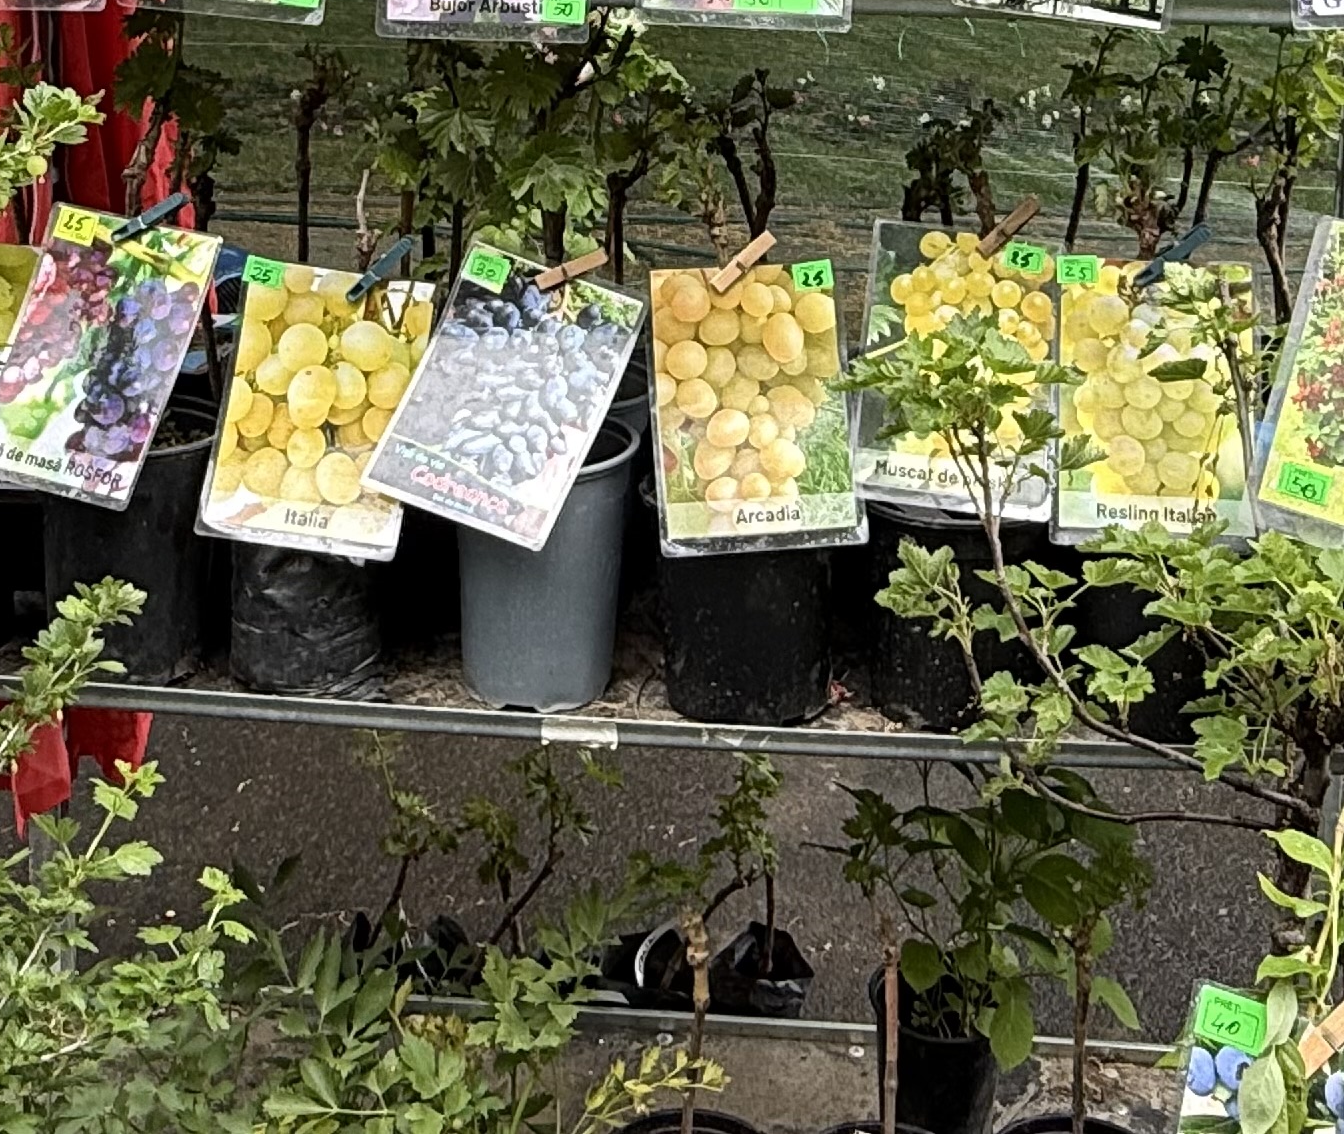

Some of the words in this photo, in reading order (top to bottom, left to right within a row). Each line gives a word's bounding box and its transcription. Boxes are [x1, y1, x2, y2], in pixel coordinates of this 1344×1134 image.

[553, 2, 573, 17] 50
[249, 266, 274, 284] 25
[474, 262, 497, 278] 30
[802, 269, 824, 286] 25
[1064, 266, 1090, 281] 25
[6, 447, 23, 463] de
[875, 459, 934, 482] Muscat
[938, 468, 959, 486] de
[1291, 476, 1317, 499] 50
[284, 508, 329, 530] Italia
[736, 504, 801, 525] Arcadia
[1097, 502, 1159, 523] Resling
[1211, 1013, 1241, 1035] 40
